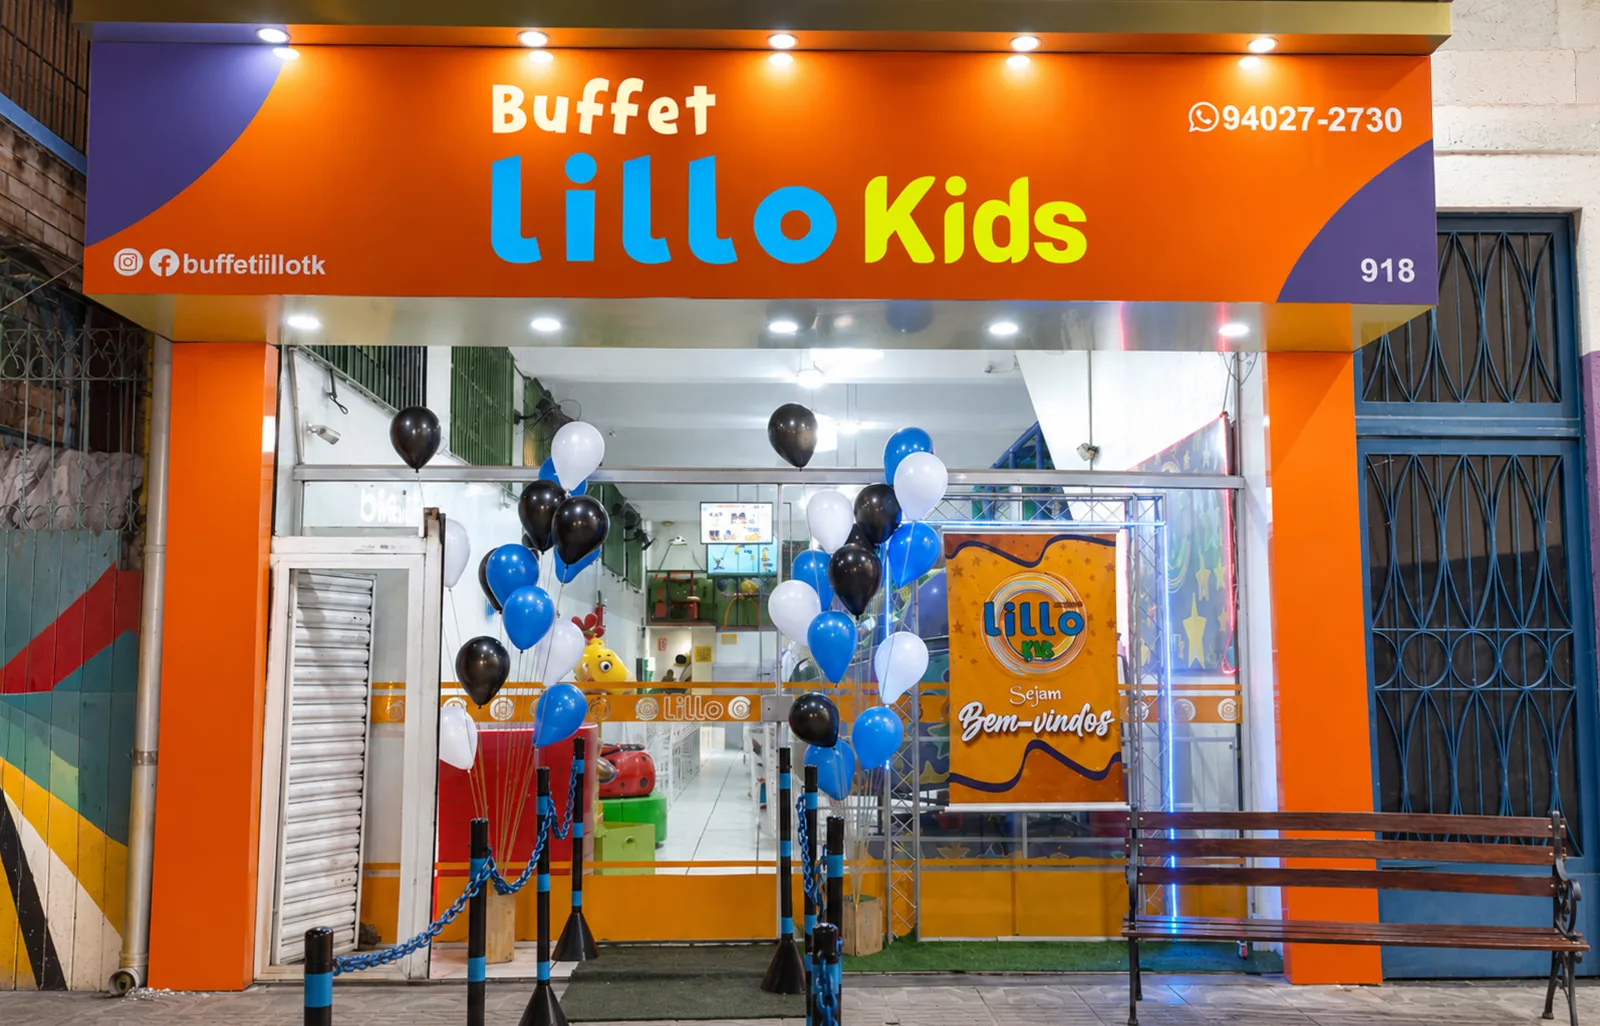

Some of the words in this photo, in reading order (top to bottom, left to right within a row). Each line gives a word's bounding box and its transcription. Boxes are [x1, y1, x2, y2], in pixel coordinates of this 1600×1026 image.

[492, 77, 716, 136] Buffet
[1222, 104, 1403, 133] 94027-2730
[864, 175, 1088, 264] Kids
[1360, 257, 1416, 283] 918
[1009, 685, 1062, 707] Sejam
[958, 700, 1115, 742] Bem-vindos
